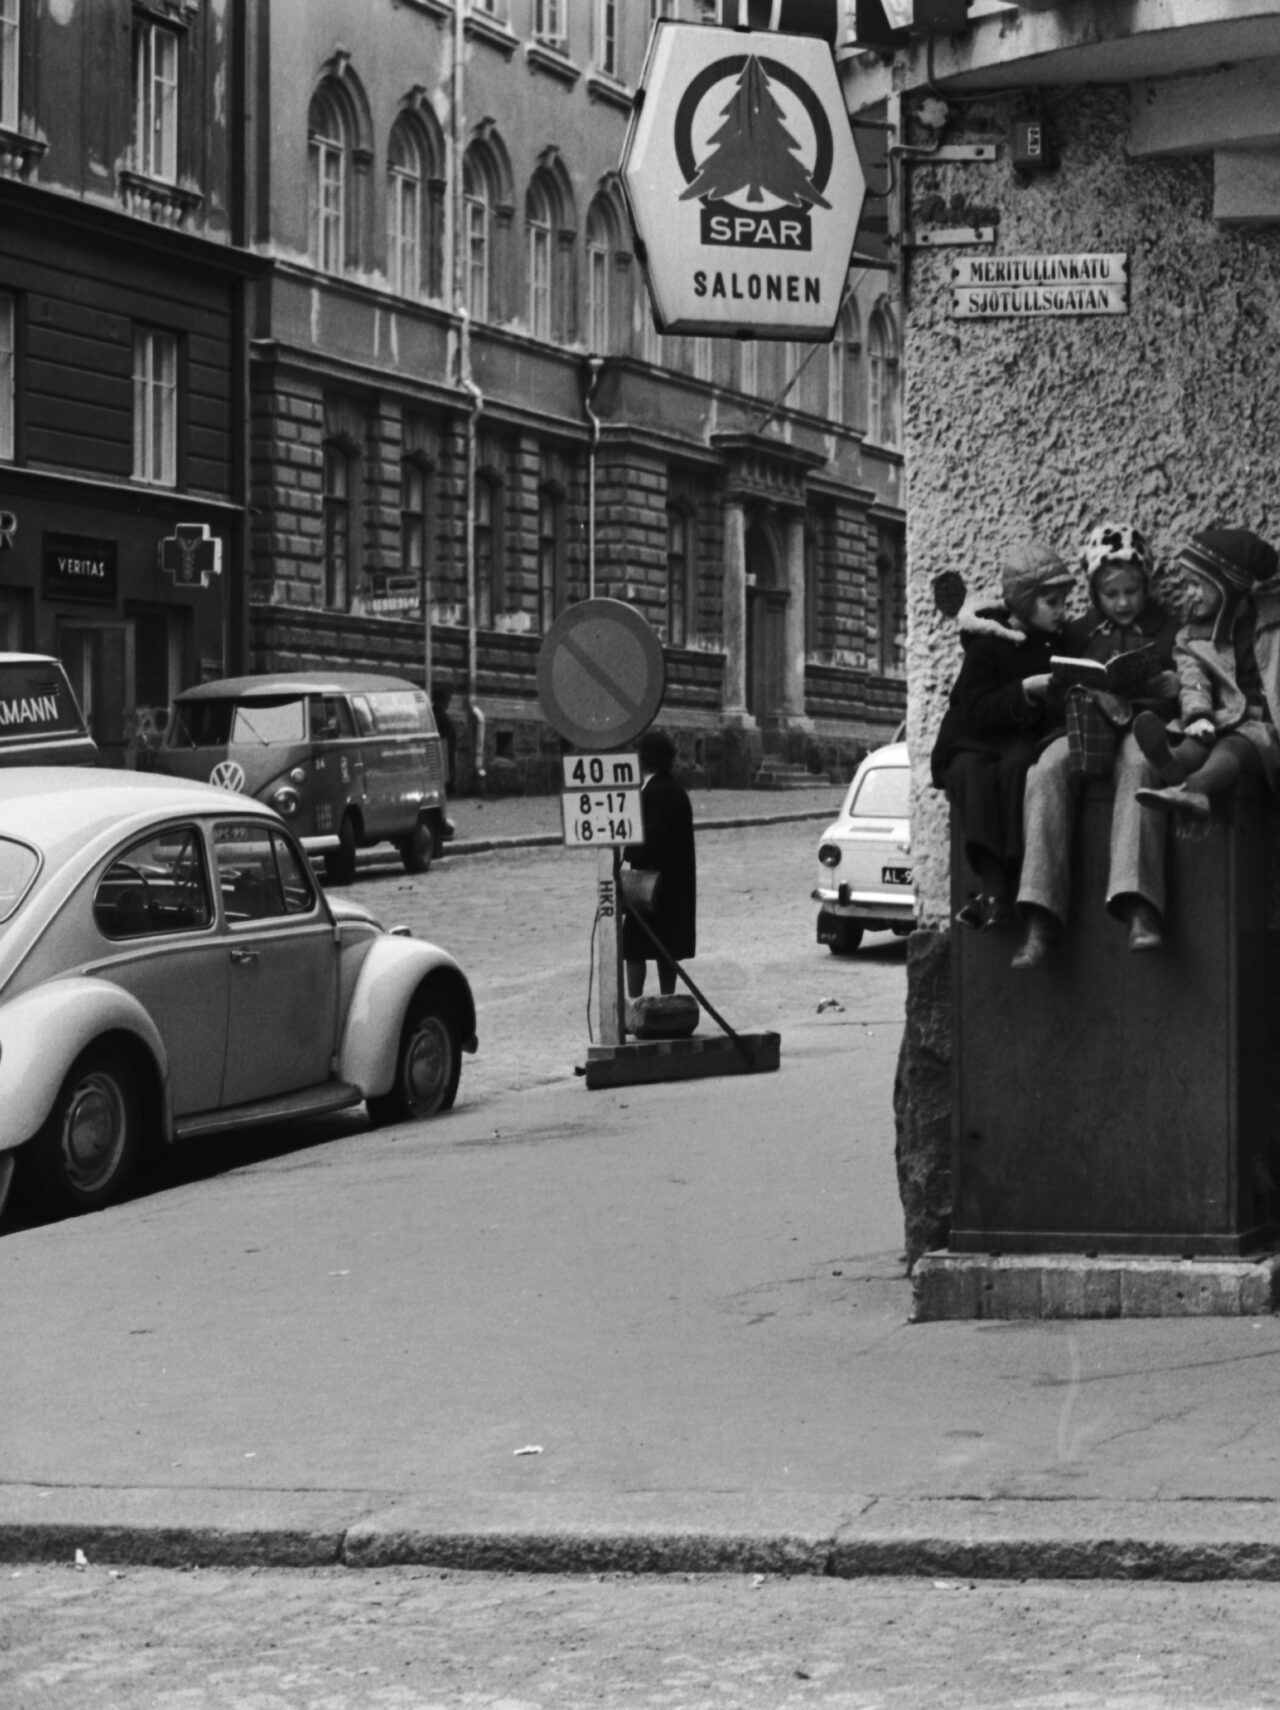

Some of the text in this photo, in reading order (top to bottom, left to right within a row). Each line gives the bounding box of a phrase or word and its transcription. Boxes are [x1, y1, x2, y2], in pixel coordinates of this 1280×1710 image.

[710, 216, 802, 245] SPAR
[969, 258, 1110, 282] MERITULLINKATU
[694, 270, 820, 304] SALONEN
[58, 557, 104, 577] VERITAS
[572, 757, 633, 784] 40 m
[579, 792, 626, 815] 8-17
[574, 818, 633, 842] (8-14)
[599, 880, 615, 918] HKR
